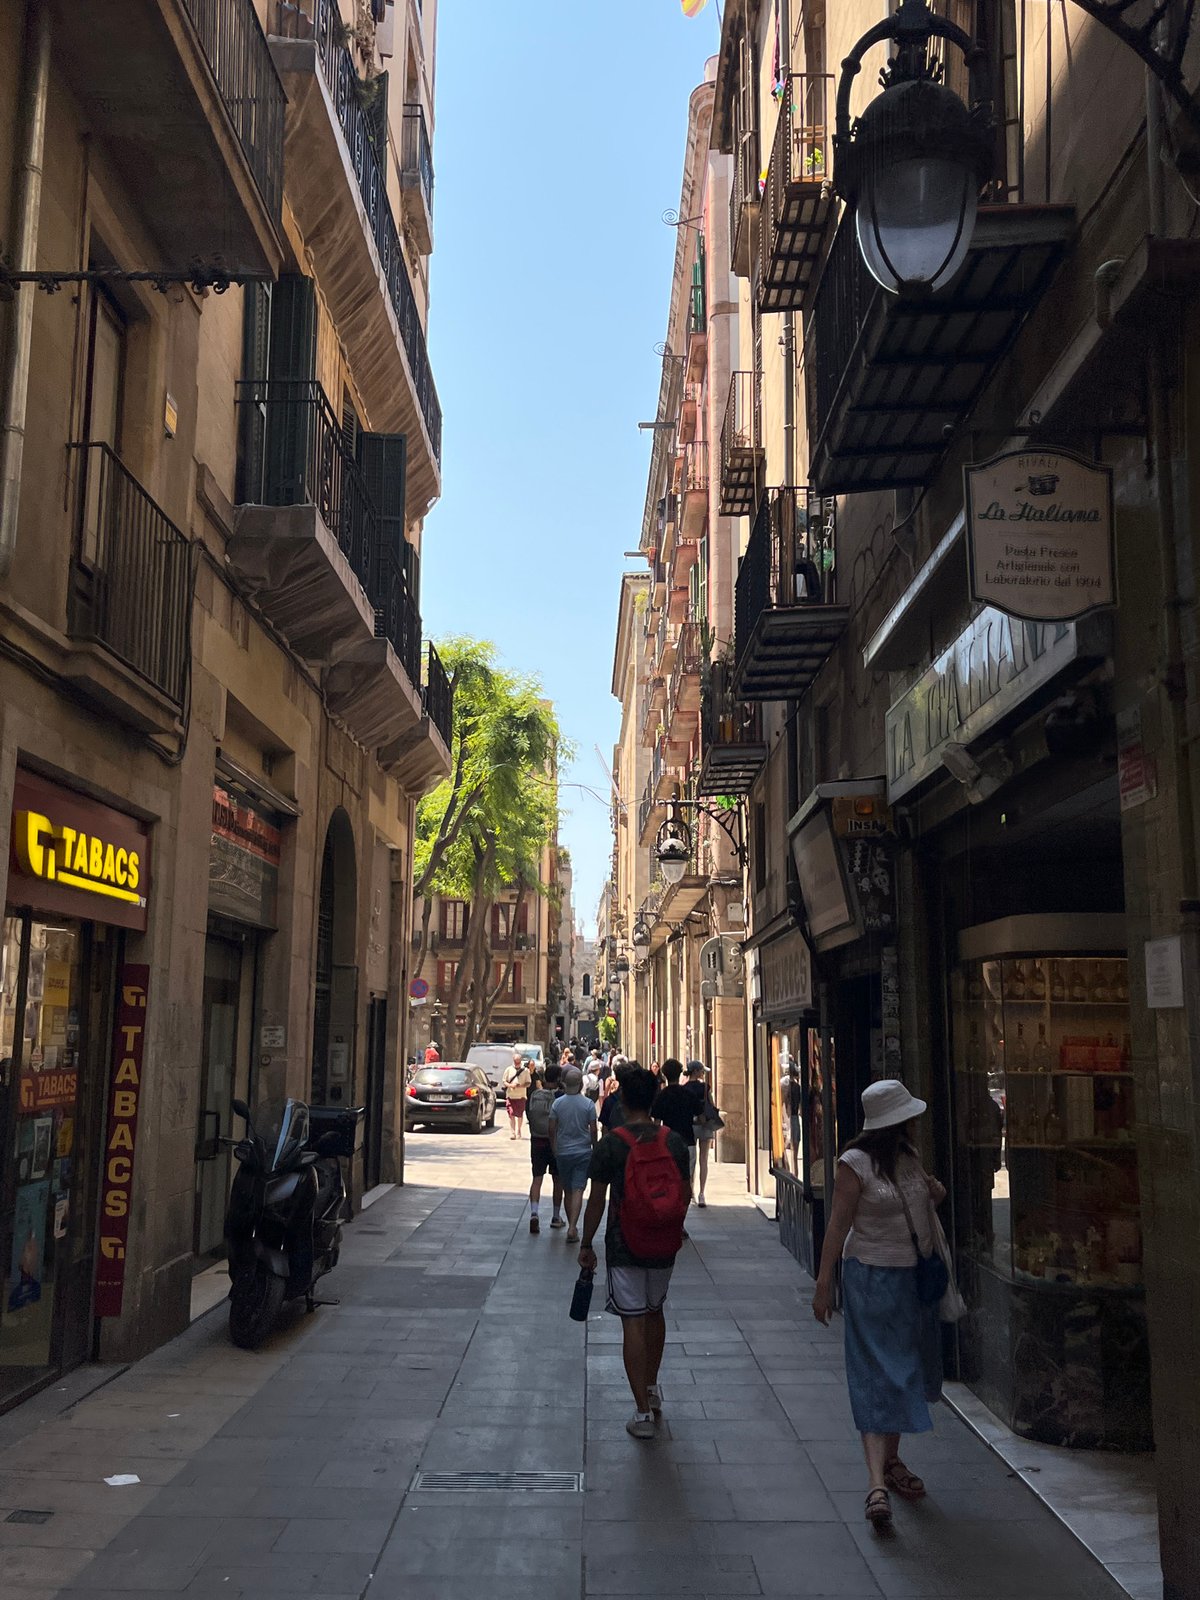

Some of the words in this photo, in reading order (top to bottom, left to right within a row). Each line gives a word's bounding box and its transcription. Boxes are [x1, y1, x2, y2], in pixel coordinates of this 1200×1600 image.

[977, 501, 1006, 521] La
[1008, 501, 1102, 523] Italiana
[985, 573, 1050, 586] Laboratorio
[890, 710, 915, 786] LA
[62, 825, 140, 889] TABACS
[38, 1074, 77, 1097] TABACS
[104, 1025, 141, 1217] TABACS
